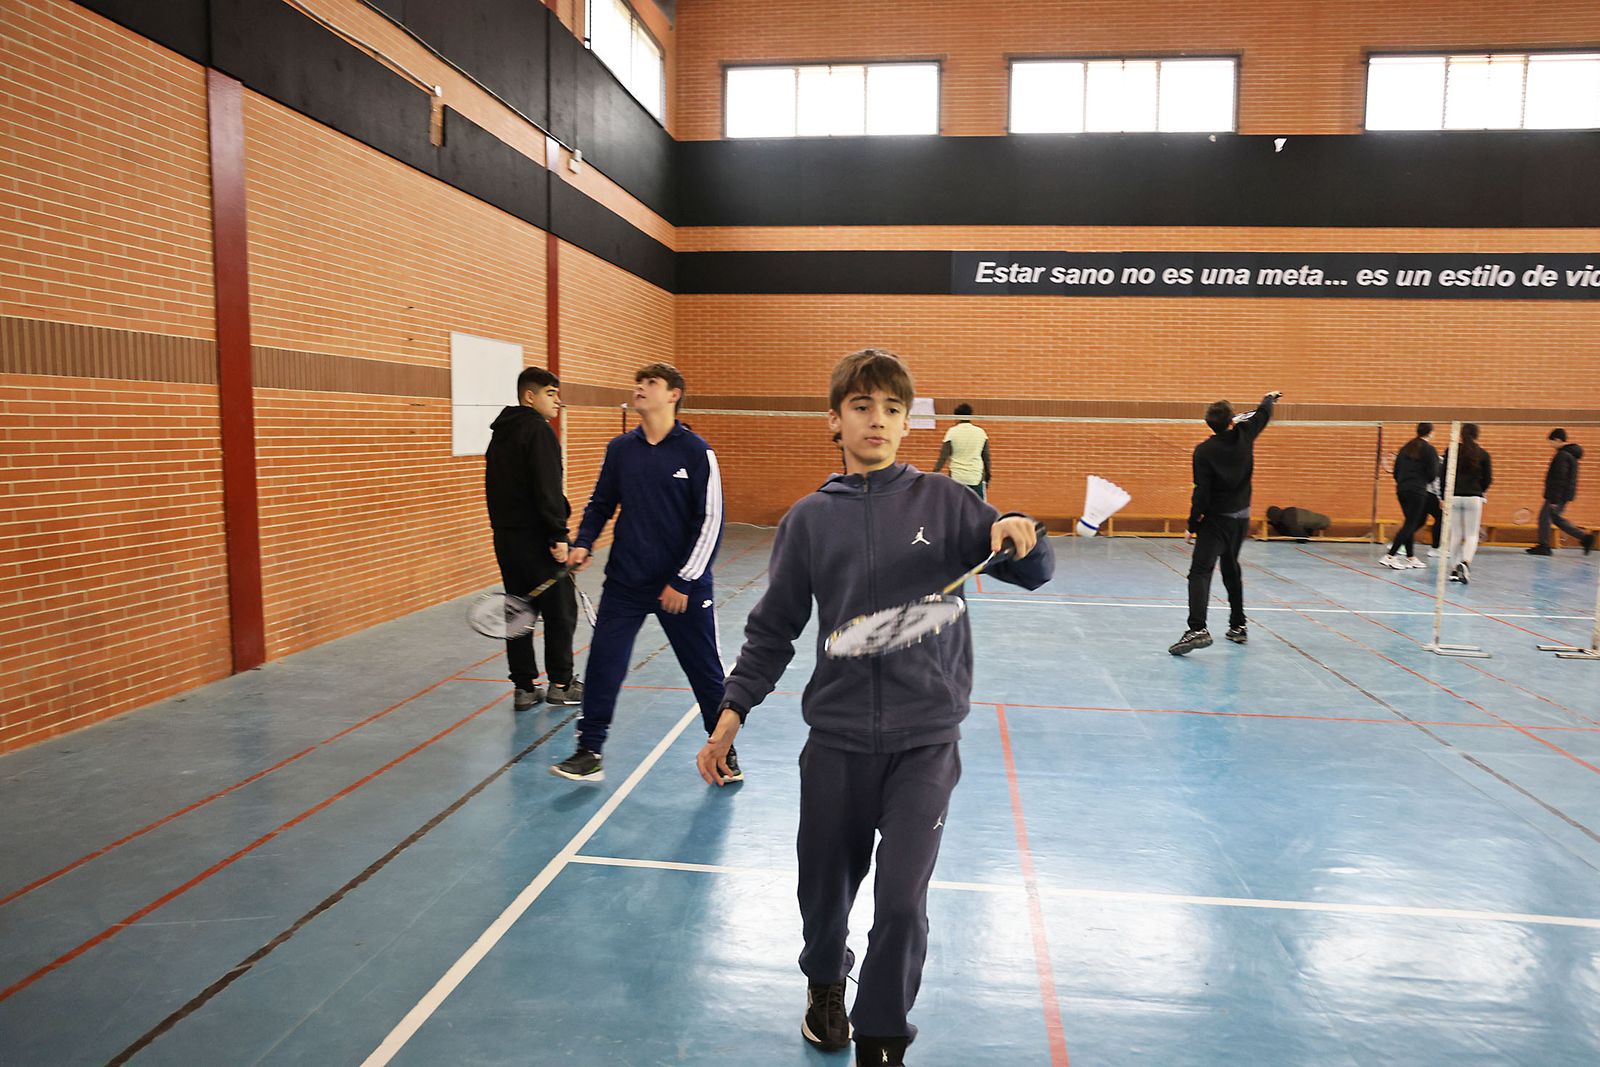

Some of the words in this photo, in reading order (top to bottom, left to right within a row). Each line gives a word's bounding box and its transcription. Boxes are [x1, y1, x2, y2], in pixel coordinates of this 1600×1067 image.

[975, 261, 1047, 283] Estar
[1050, 266, 1115, 285] sano
[1120, 267, 1156, 285] no
[1161, 268, 1194, 285] es
[1200, 268, 1251, 285] una
[1256, 265, 1348, 286] meta...
[1356, 269, 1390, 286] es
[1396, 269, 1432, 287] un
[1438, 264, 1516, 287] estilo
[1521, 264, 1559, 287] de
